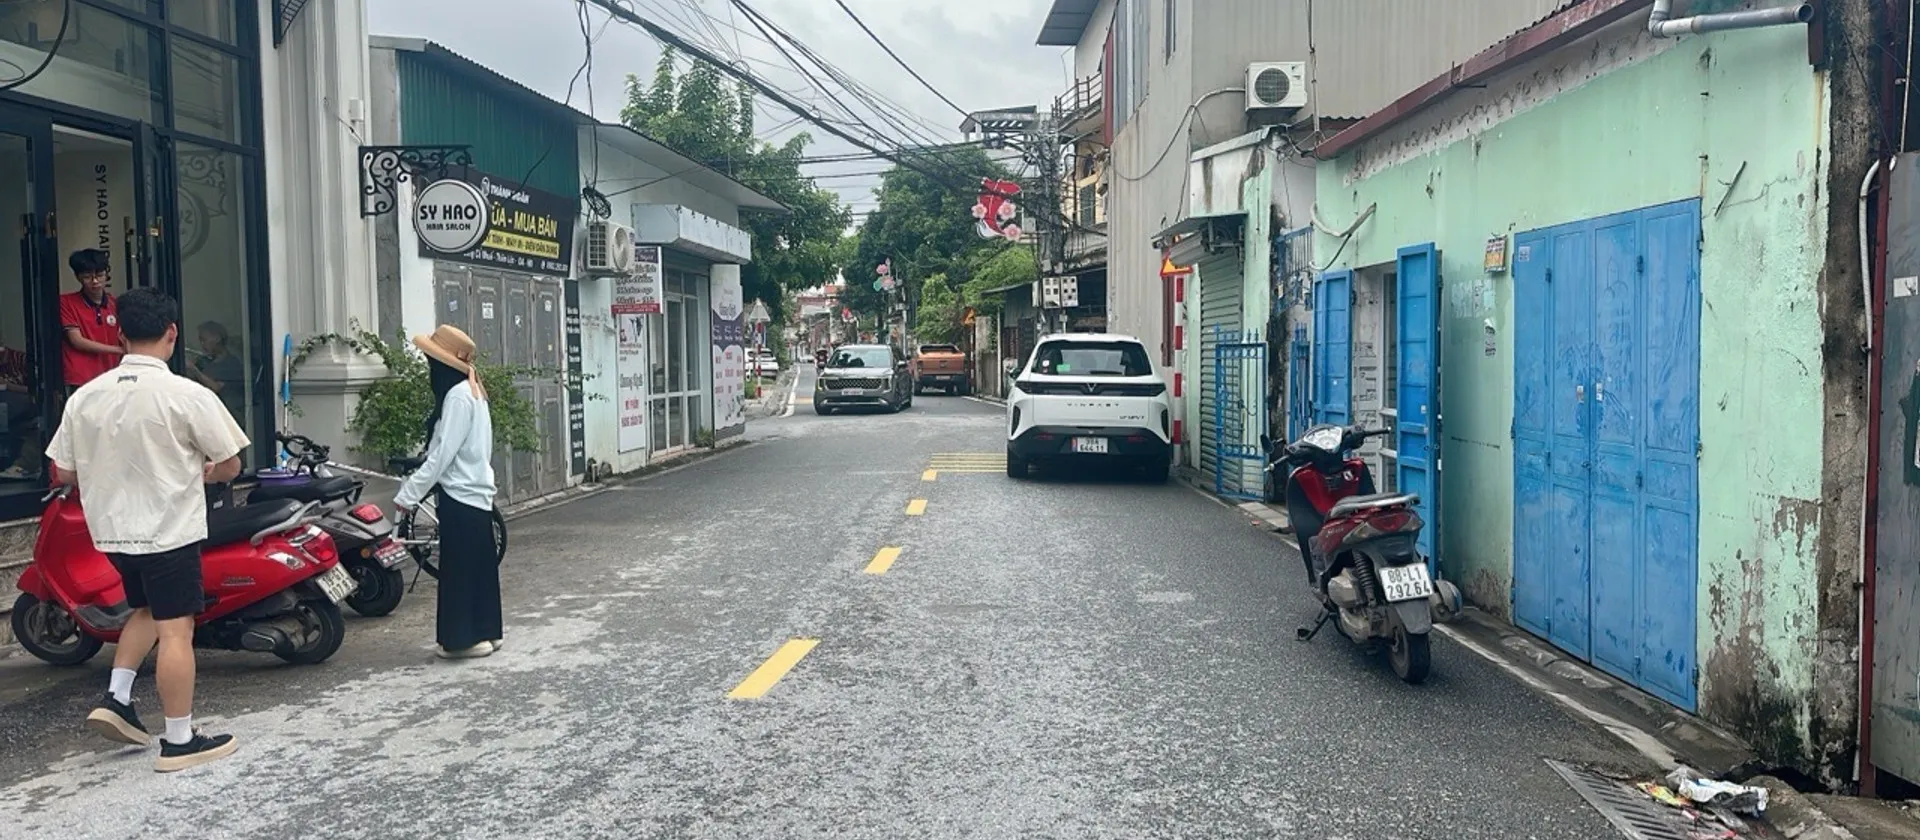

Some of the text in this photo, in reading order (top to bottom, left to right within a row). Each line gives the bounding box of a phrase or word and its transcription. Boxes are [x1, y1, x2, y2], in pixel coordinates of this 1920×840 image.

[95, 164, 106, 184] SY
[96, 188, 109, 220] HAO
[420, 204, 477, 220] SY HAO
[426, 223, 471, 231] HAIR SALON
[491, 201, 507, 228] ỬA
[514, 210, 537, 234] MUA
[537, 214, 558, 239] BÁN
[1388, 566, 1422, 583] 88-L1
